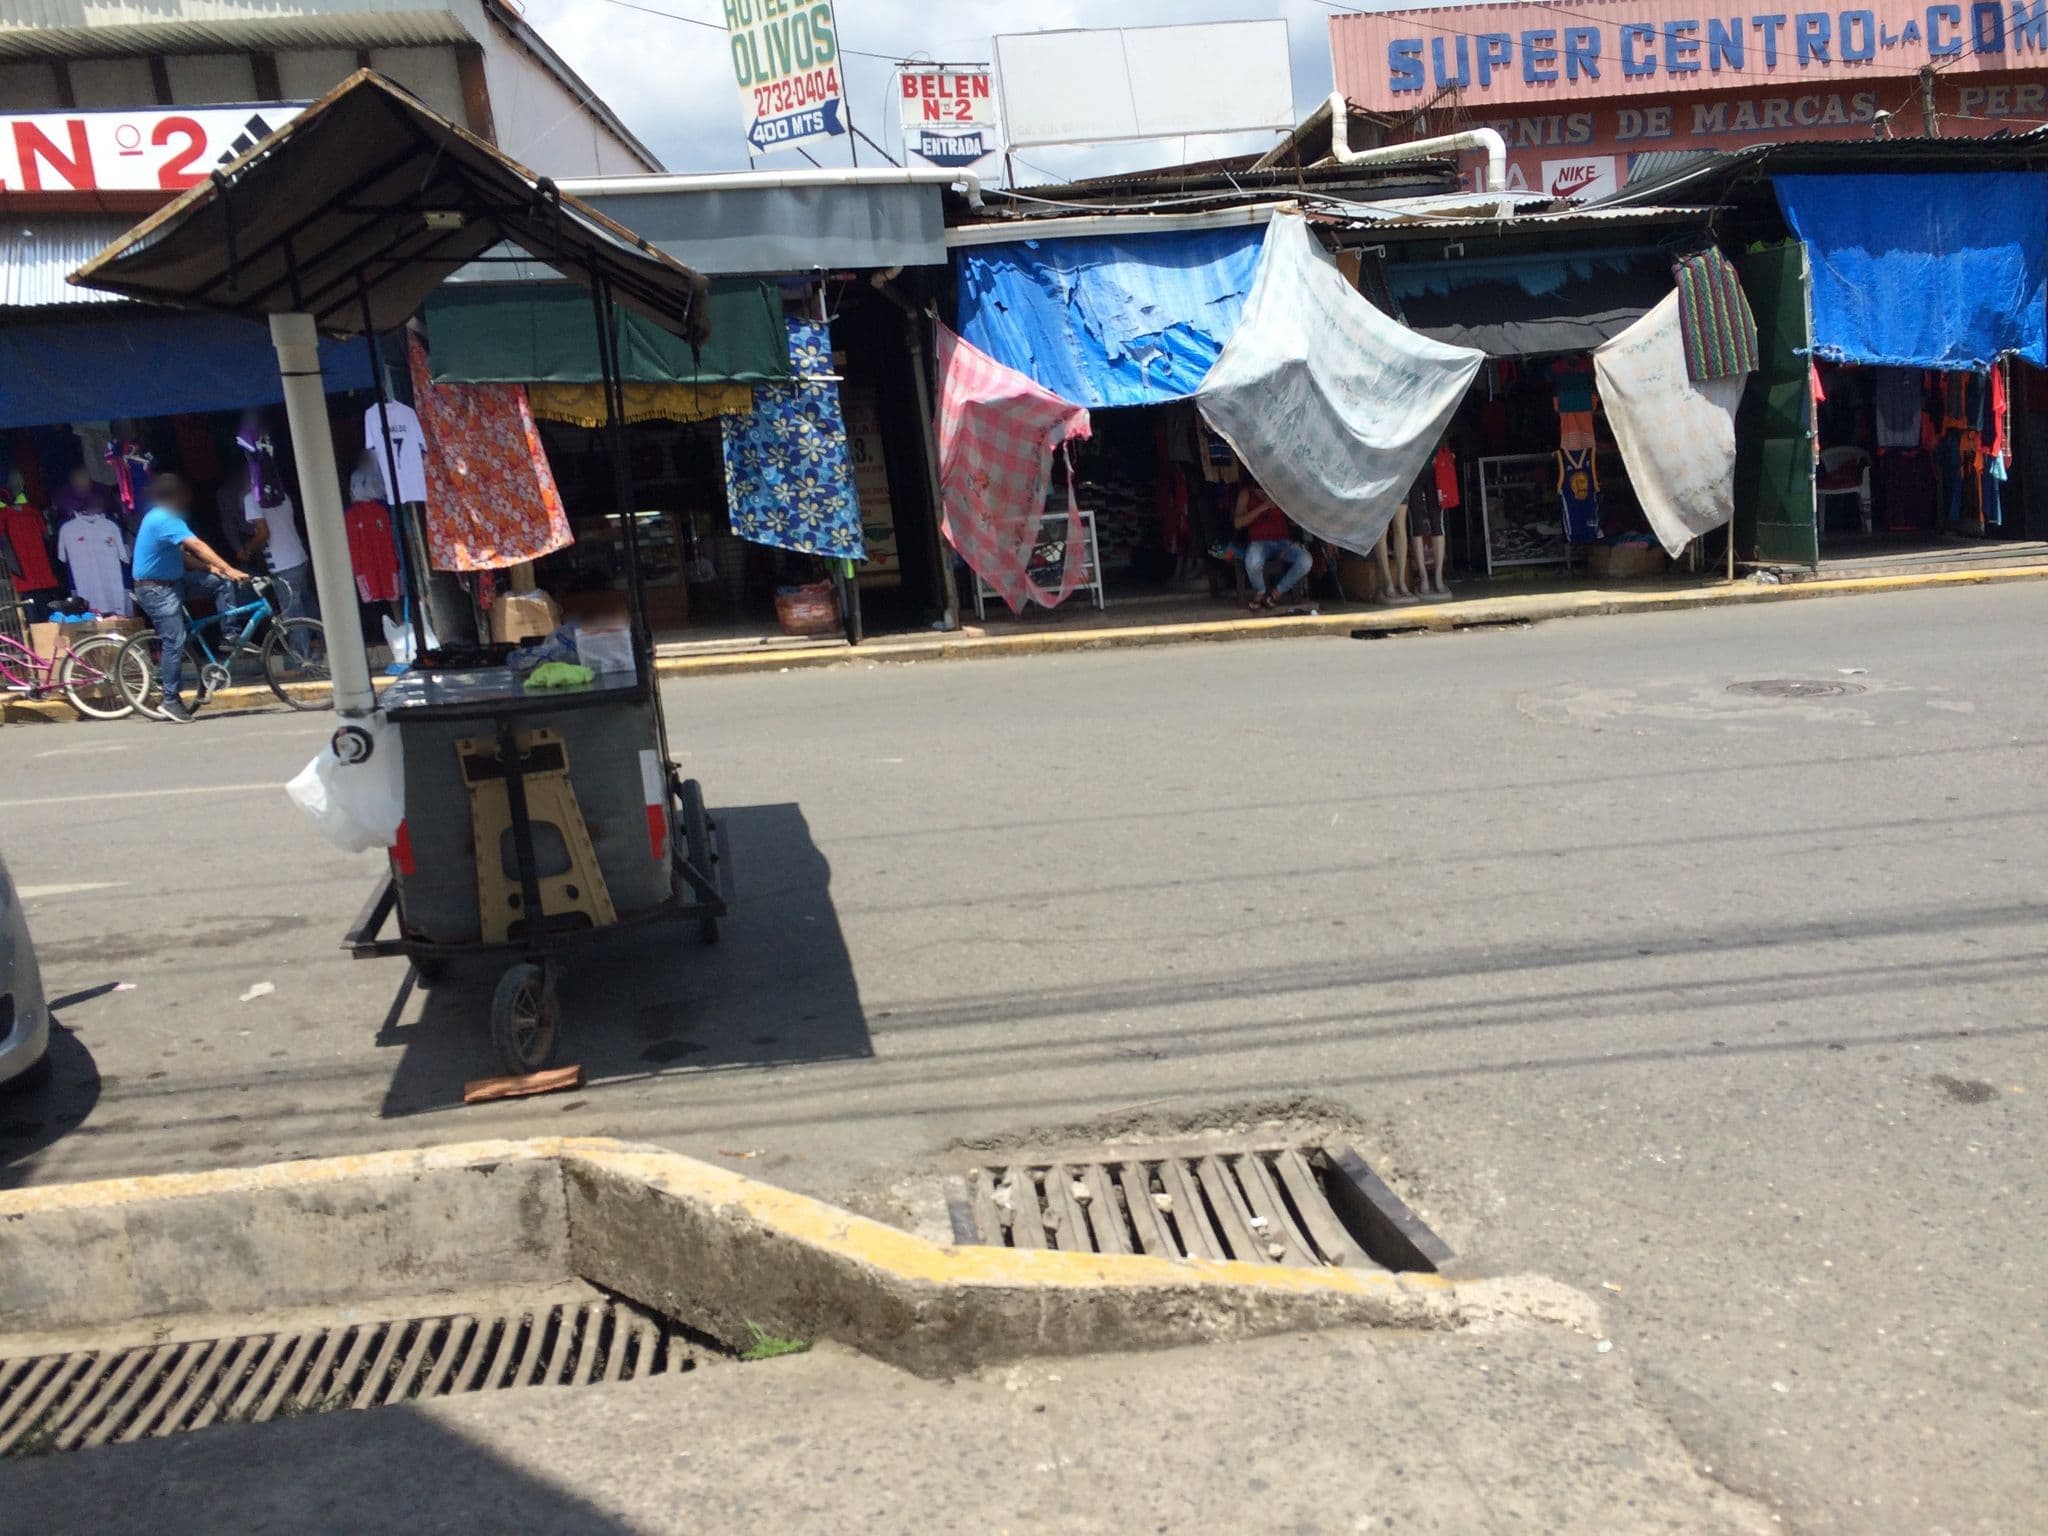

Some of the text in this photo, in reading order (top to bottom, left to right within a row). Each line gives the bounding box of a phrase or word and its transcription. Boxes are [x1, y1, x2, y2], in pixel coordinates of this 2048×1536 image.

[731, 3, 836, 87] OLIVOS
[1388, 0, 2048, 91] SUPER CENTRO LA COM
[902, 75, 989, 98] BELEN
[753, 111, 824, 143] 400 MTS
[1467, 83, 2047, 147] ENIS DE MARCAS PER
[922, 138, 982, 156] ENTRADA
[1558, 165, 1595, 183] NIKE
